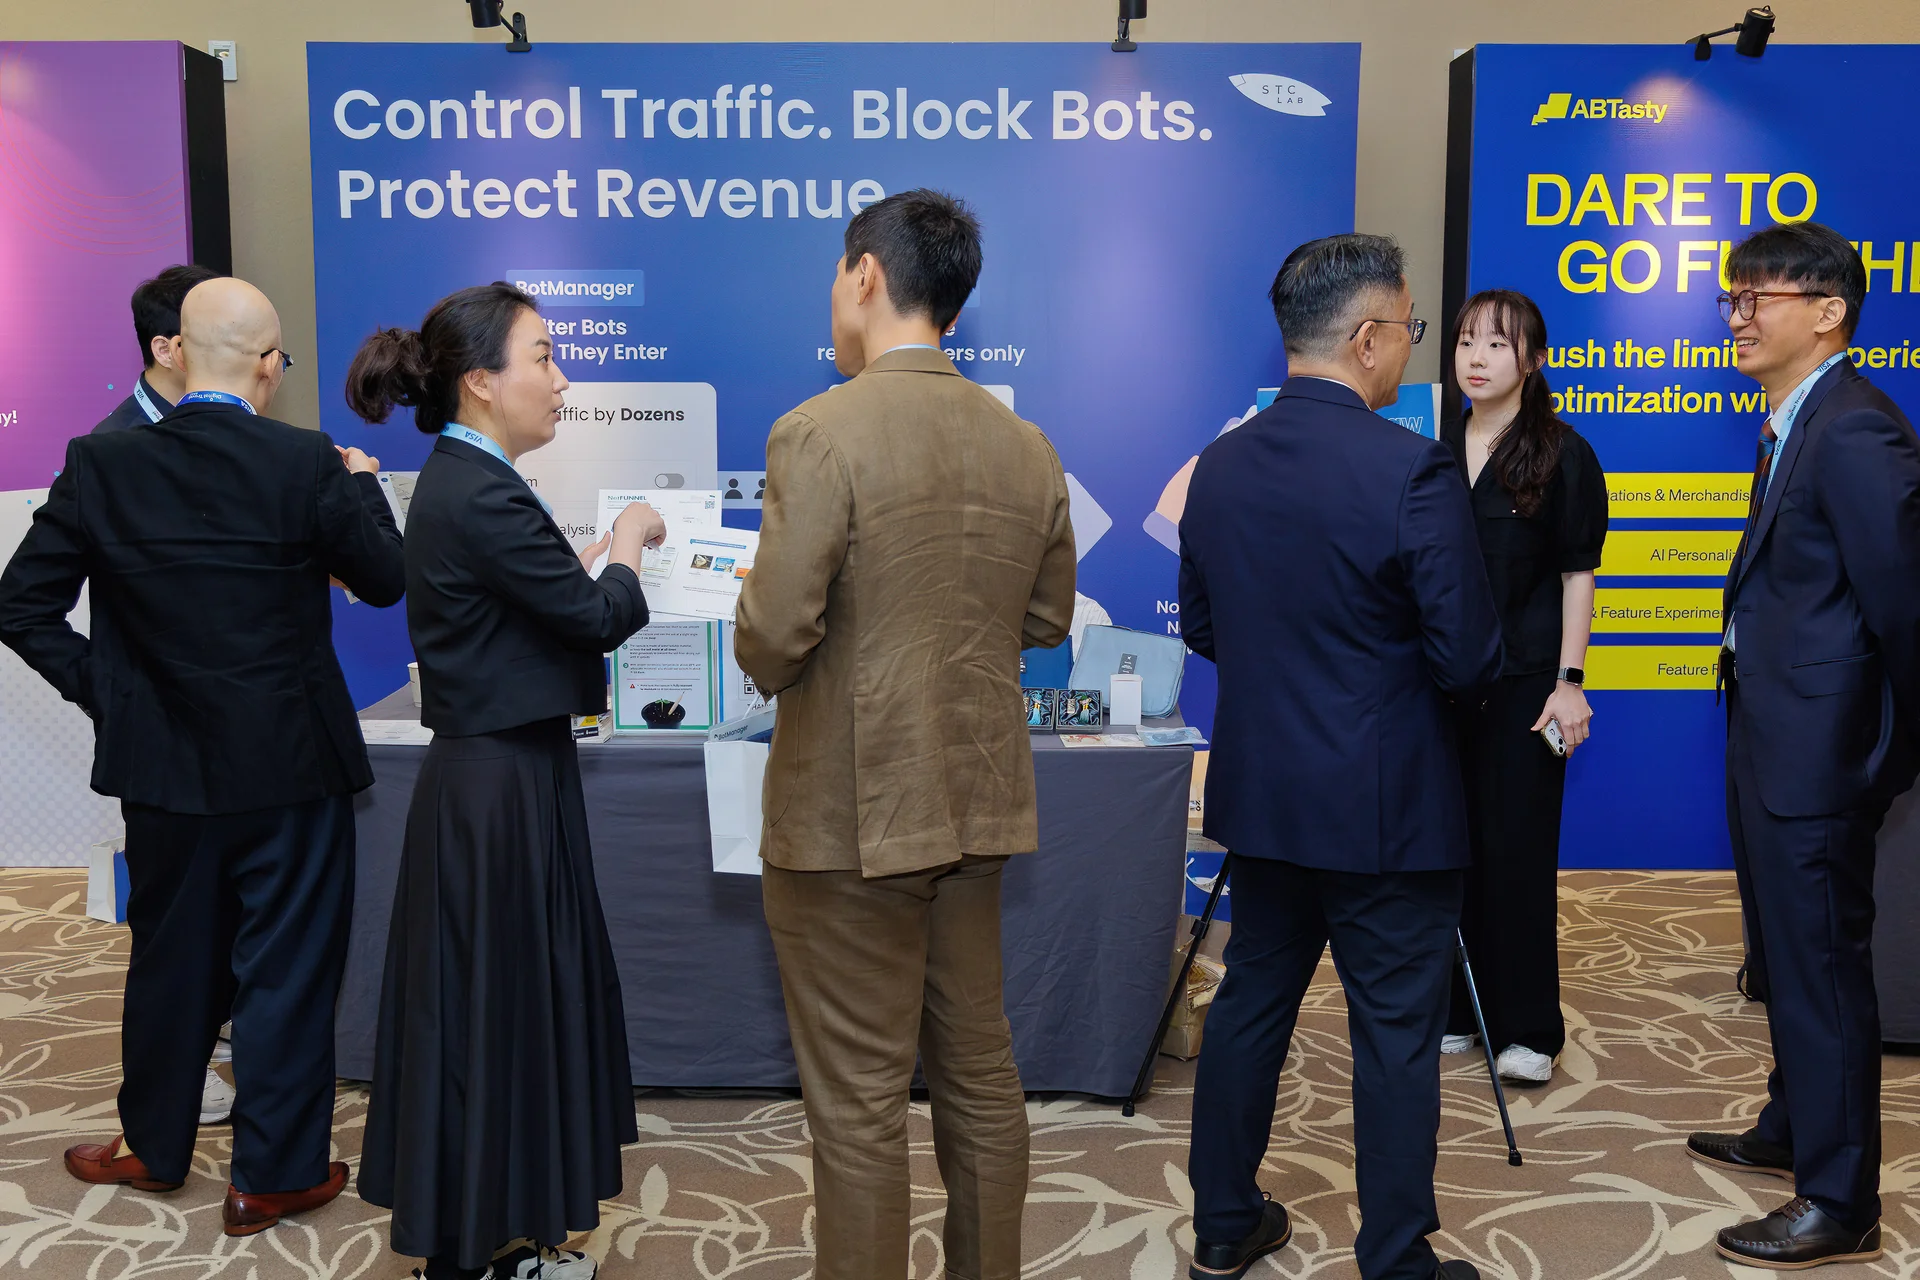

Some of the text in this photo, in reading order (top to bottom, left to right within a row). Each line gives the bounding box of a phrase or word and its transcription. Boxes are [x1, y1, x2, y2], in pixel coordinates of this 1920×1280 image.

[1261, 84, 1297, 95] STC
[333, 83, 1213, 141] Control Traffic. Block Bots.
[338, 169, 578, 219] Protect
[1526, 172, 1818, 226] DARE TO
[1557, 239, 1662, 294] GO
[515, 280, 635, 301] BotManager
[581, 318, 628, 336] Bots
[557, 343, 668, 366] They Enter
[980, 344, 1026, 367] only
[1547, 338, 1606, 369] ush
[1612, 338, 1666, 369] the
[1817, 361, 1832, 373] VISA
[594, 407, 616, 426] by
[620, 407, 685, 421] Dozens
[464, 430, 484, 445] VISA
[1654, 488, 1666, 502] &
[1650, 548, 1665, 562] AI
[1600, 606, 1652, 619] Feature
[1657, 663, 1709, 676] Feature
[718, 725, 748, 740] BotManager
